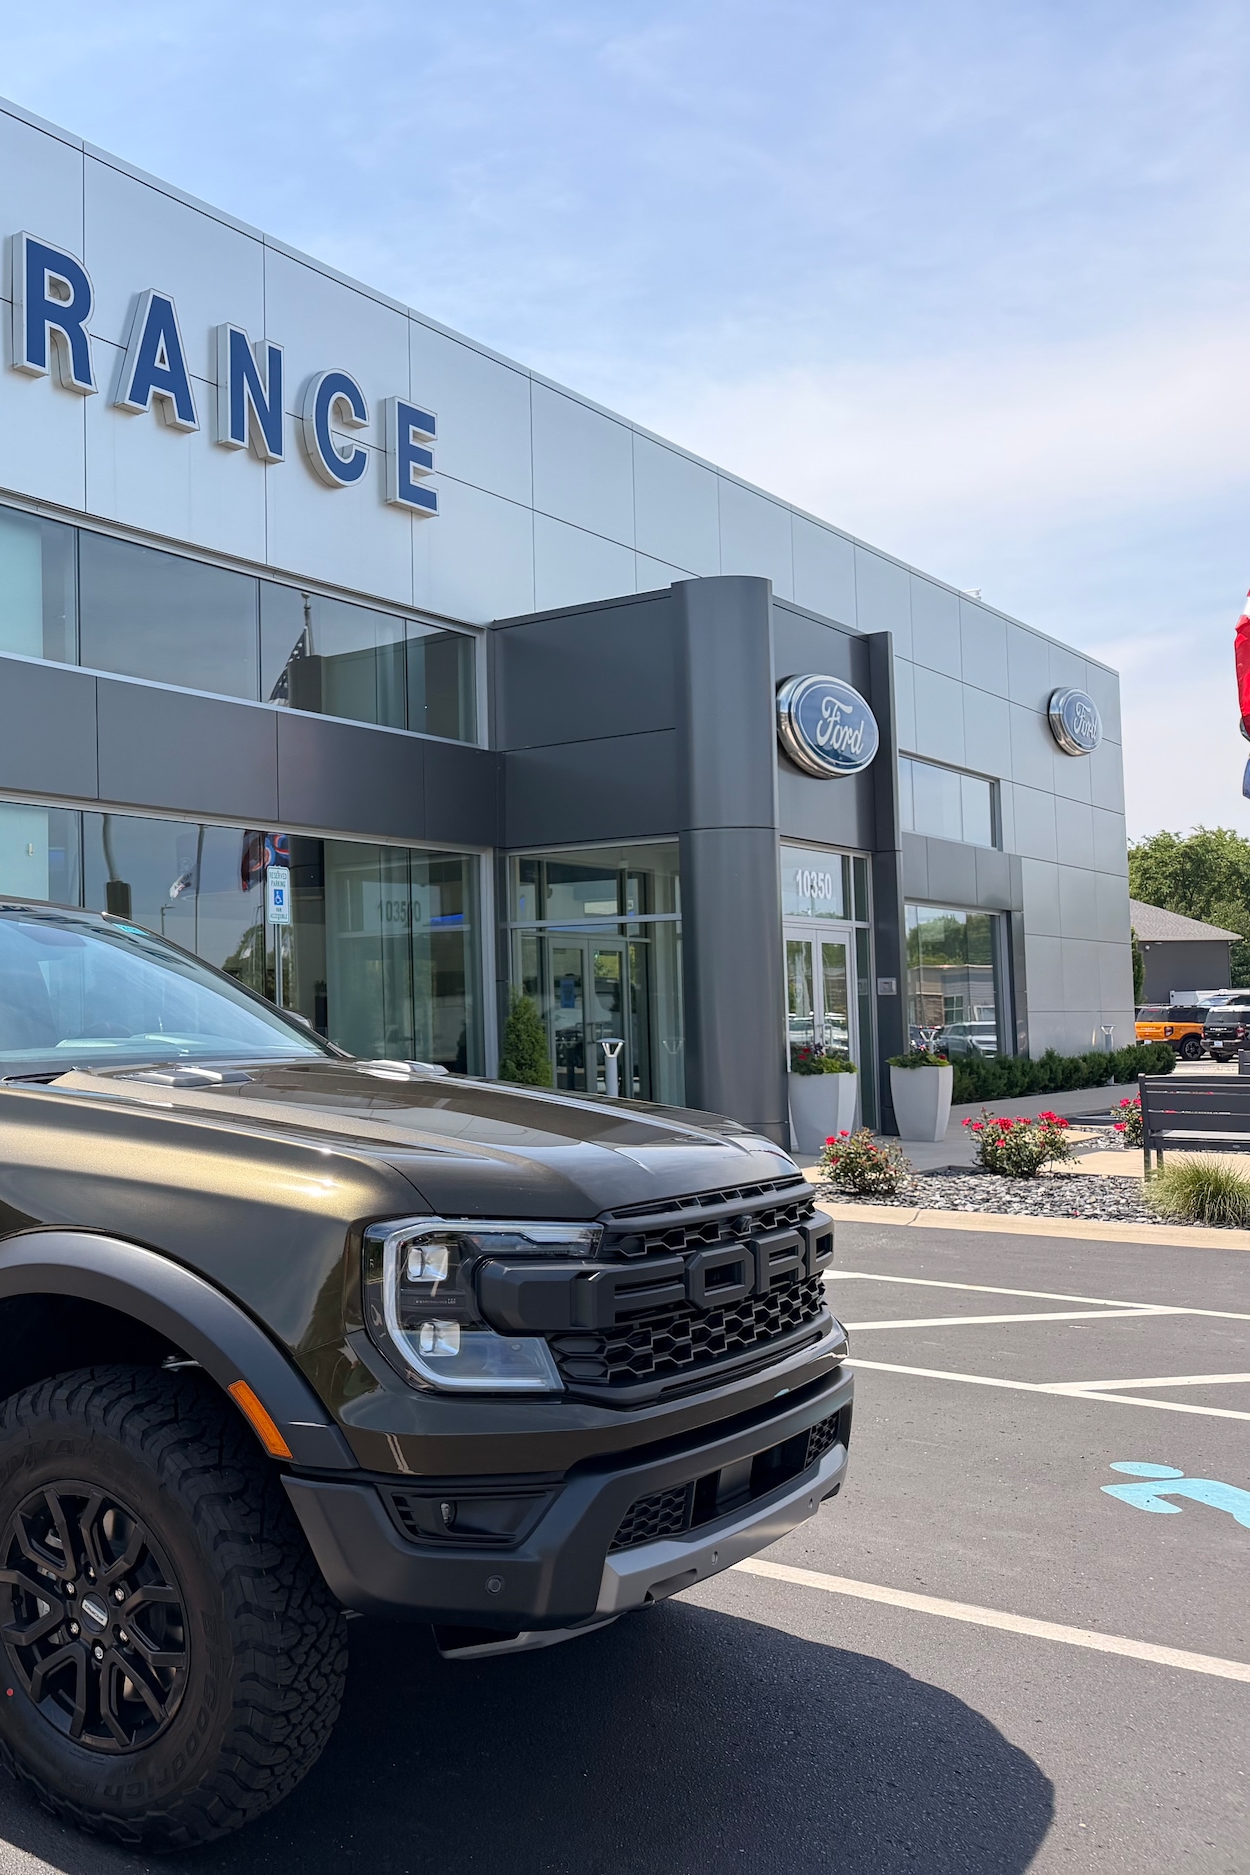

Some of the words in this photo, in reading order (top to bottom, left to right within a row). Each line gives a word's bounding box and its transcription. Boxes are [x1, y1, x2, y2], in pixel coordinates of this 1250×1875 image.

[816, 696, 865, 755] Ford
[1073, 701, 1098, 740] Ford
[796, 869, 832, 900] 10350
[570, 1209, 835, 1332] FORD
